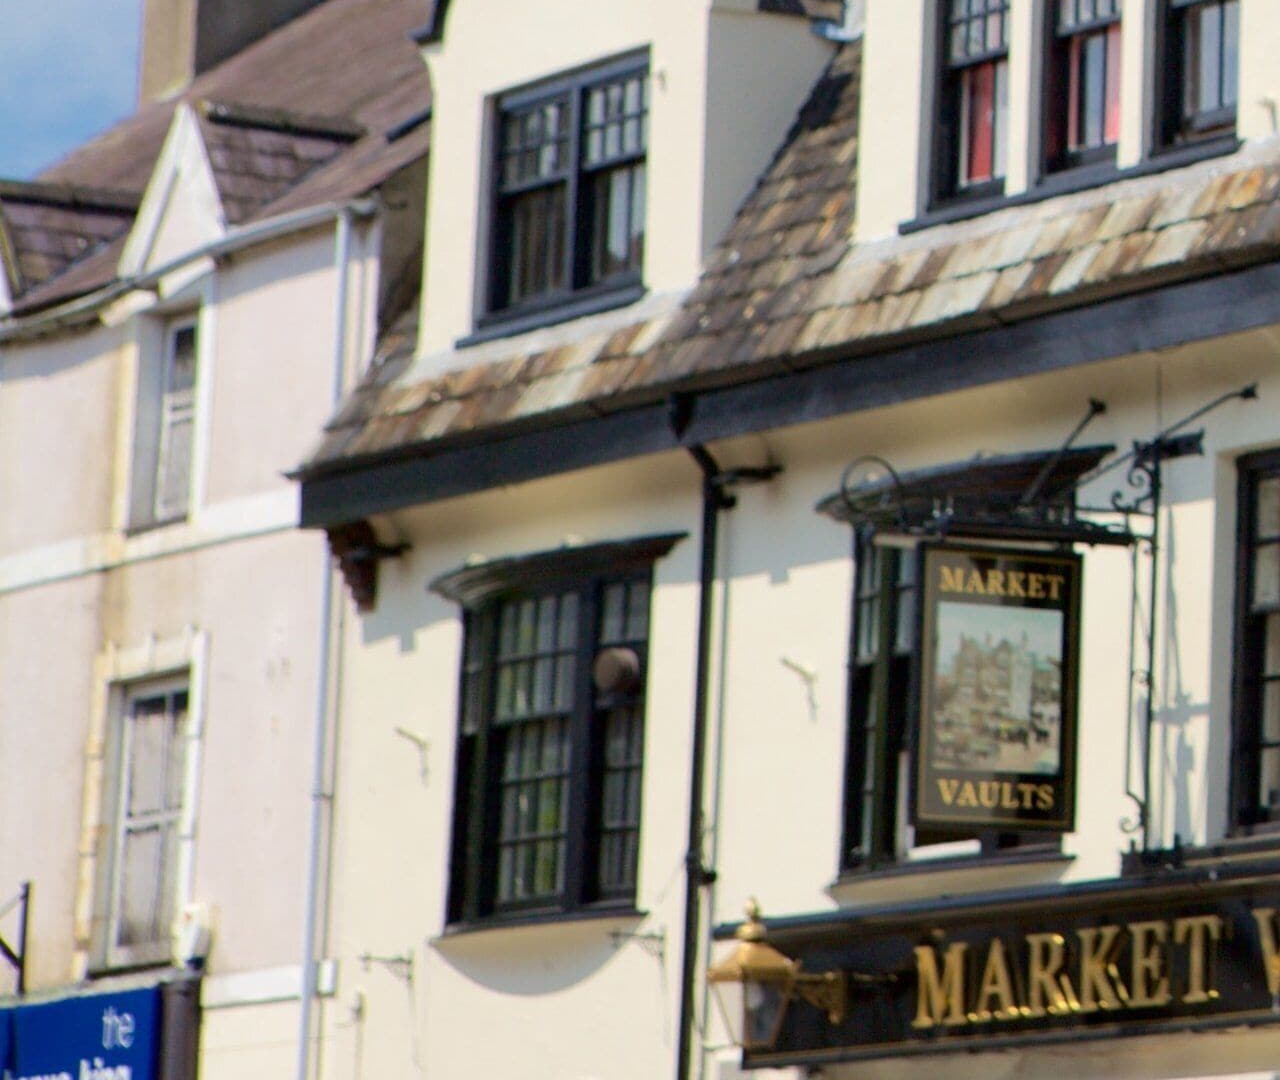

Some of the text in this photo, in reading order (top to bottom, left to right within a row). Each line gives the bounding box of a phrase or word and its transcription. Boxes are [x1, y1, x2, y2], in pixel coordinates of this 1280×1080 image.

[939, 565, 1065, 600] MARKET
[936, 778, 1055, 811] VAULTS
[911, 915, 1221, 1029] MARKET
